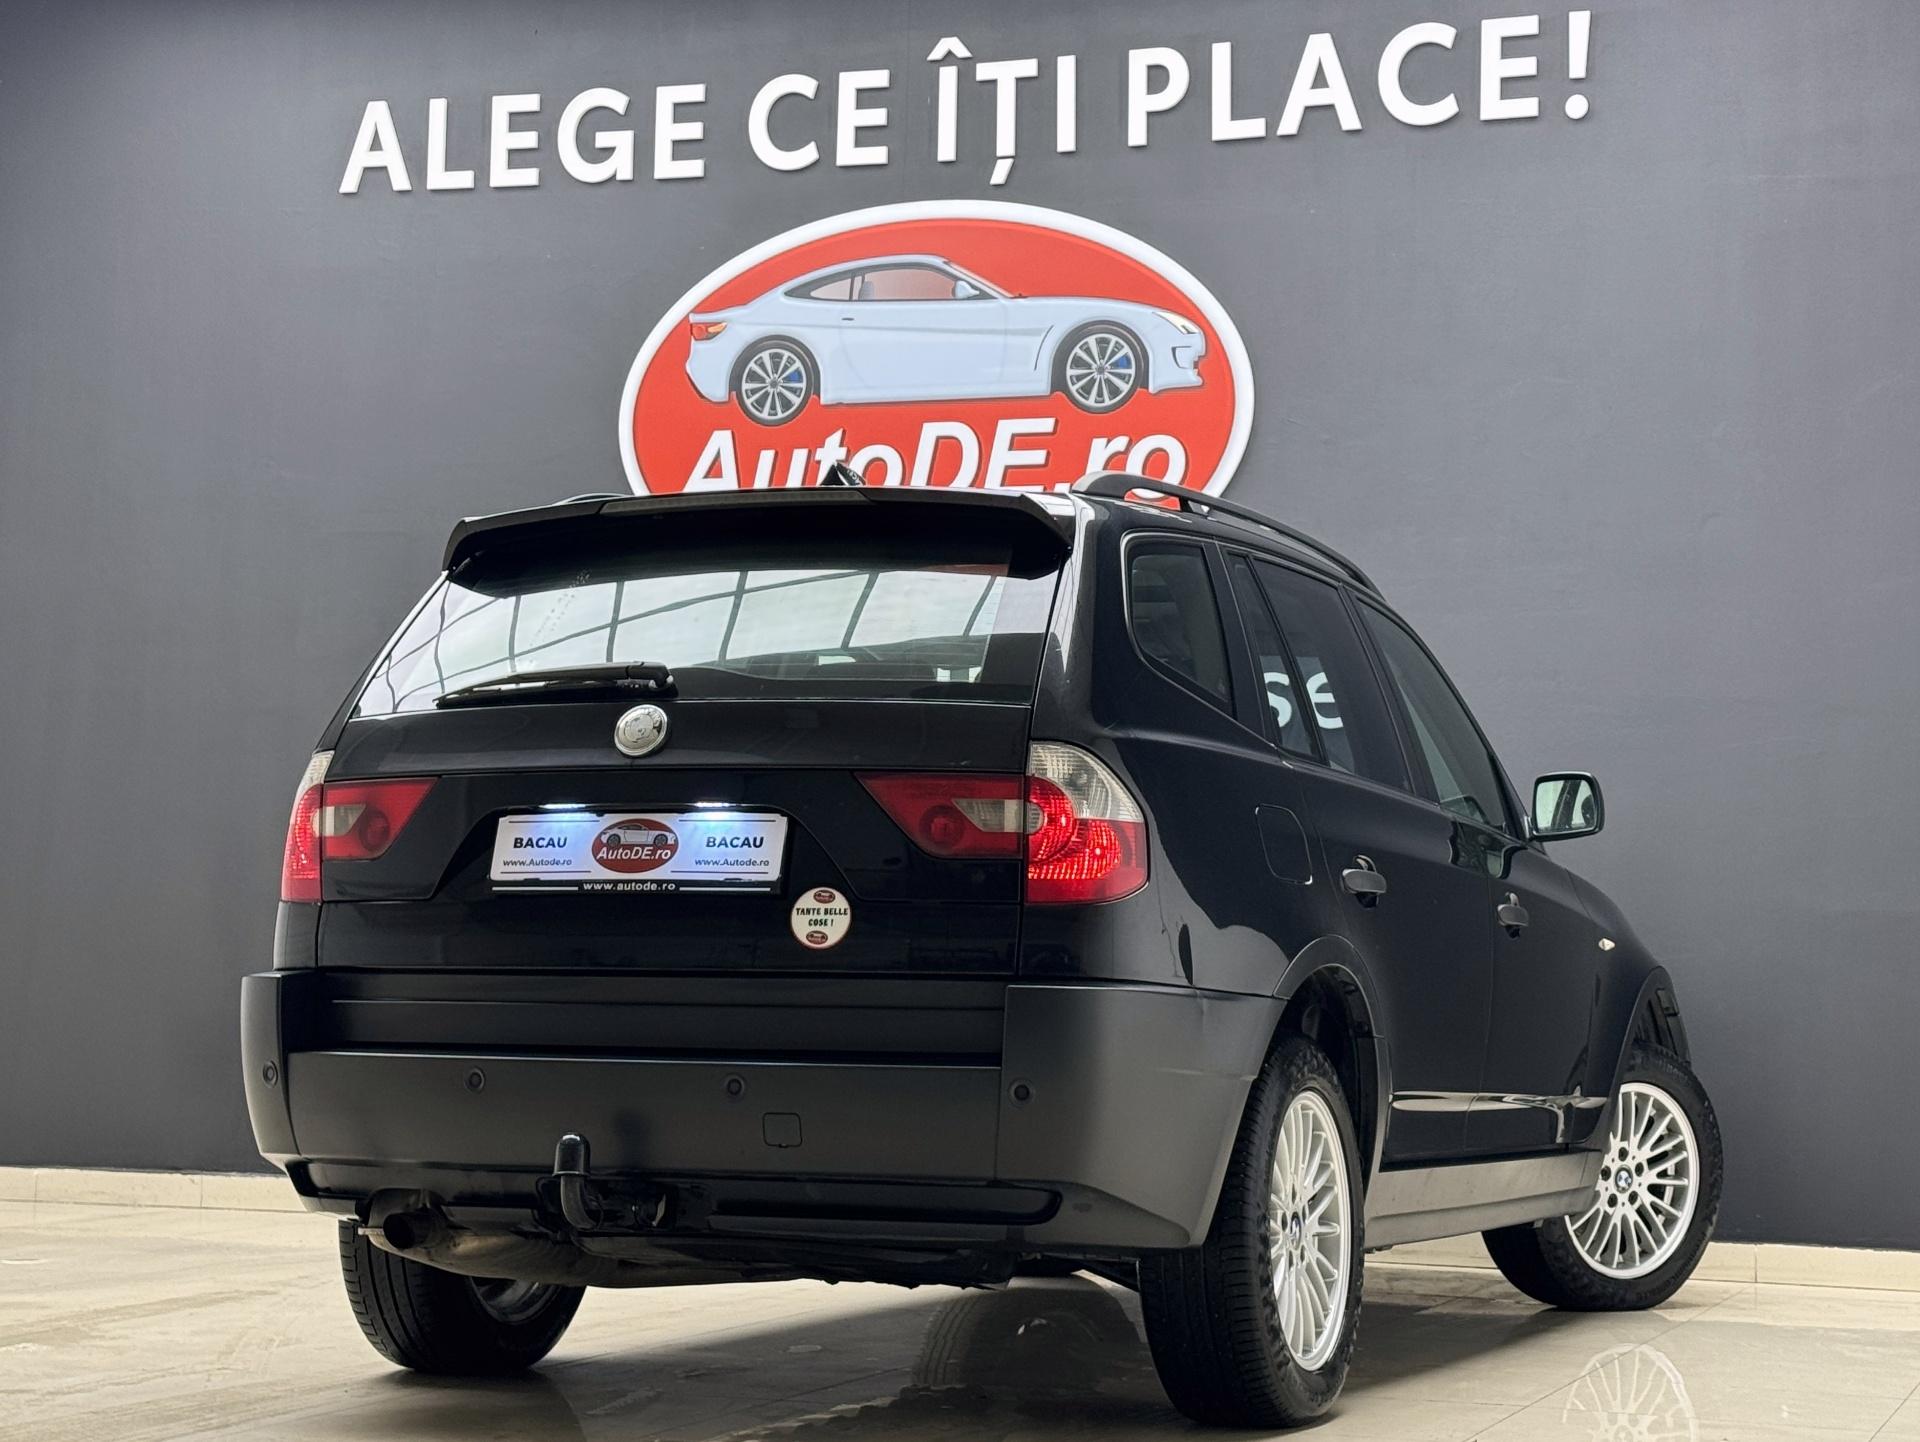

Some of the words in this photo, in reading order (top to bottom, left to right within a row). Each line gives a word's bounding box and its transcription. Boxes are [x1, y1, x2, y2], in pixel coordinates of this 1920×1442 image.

[339, 84, 706, 194] ALEGE
[748, 69, 890, 171] CE
[927, 37, 1077, 185] ÎȚI
[1127, 10, 1592, 148] PLACE!
[513, 837, 567, 848] BACAU
[706, 836, 764, 848] BACAU
[597, 847, 671, 861] AutoDE.ro
[503, 858, 572, 867] www.Autode.ro
[695, 858, 769, 867] www.Autode.ro
[583, 881, 675, 892] www.autode.ro
[795, 907, 821, 916] TANTE
[823, 907, 849, 916] BELLE
[808, 919, 828, 927] COSE
